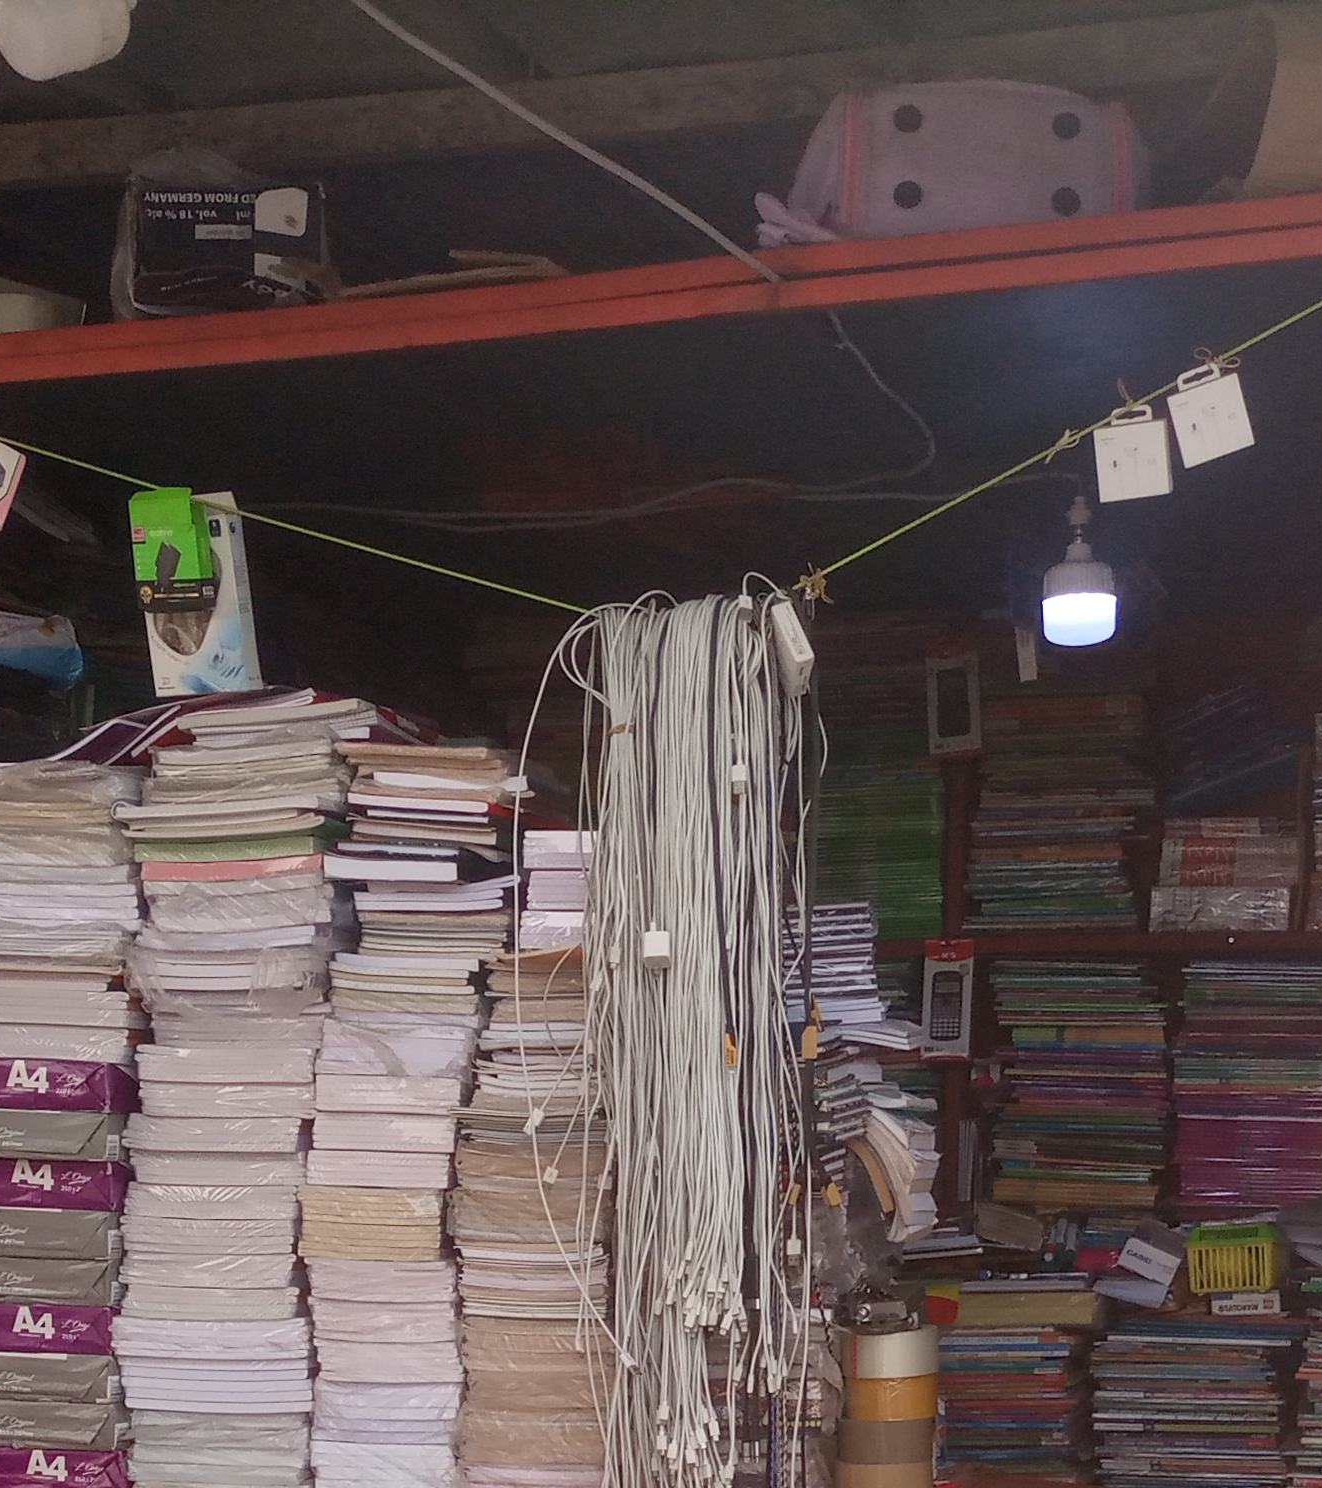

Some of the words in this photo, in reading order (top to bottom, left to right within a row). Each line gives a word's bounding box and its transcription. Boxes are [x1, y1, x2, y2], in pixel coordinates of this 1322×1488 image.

[144, 192, 201, 203] GERMANY
[205, 193, 238, 203] FROM
[6, 1060, 48, 1093] A4
[11, 1159, 54, 1190] A4
[12, 1306, 55, 1338] A4
[26, 1449, 68, 1481] A4
